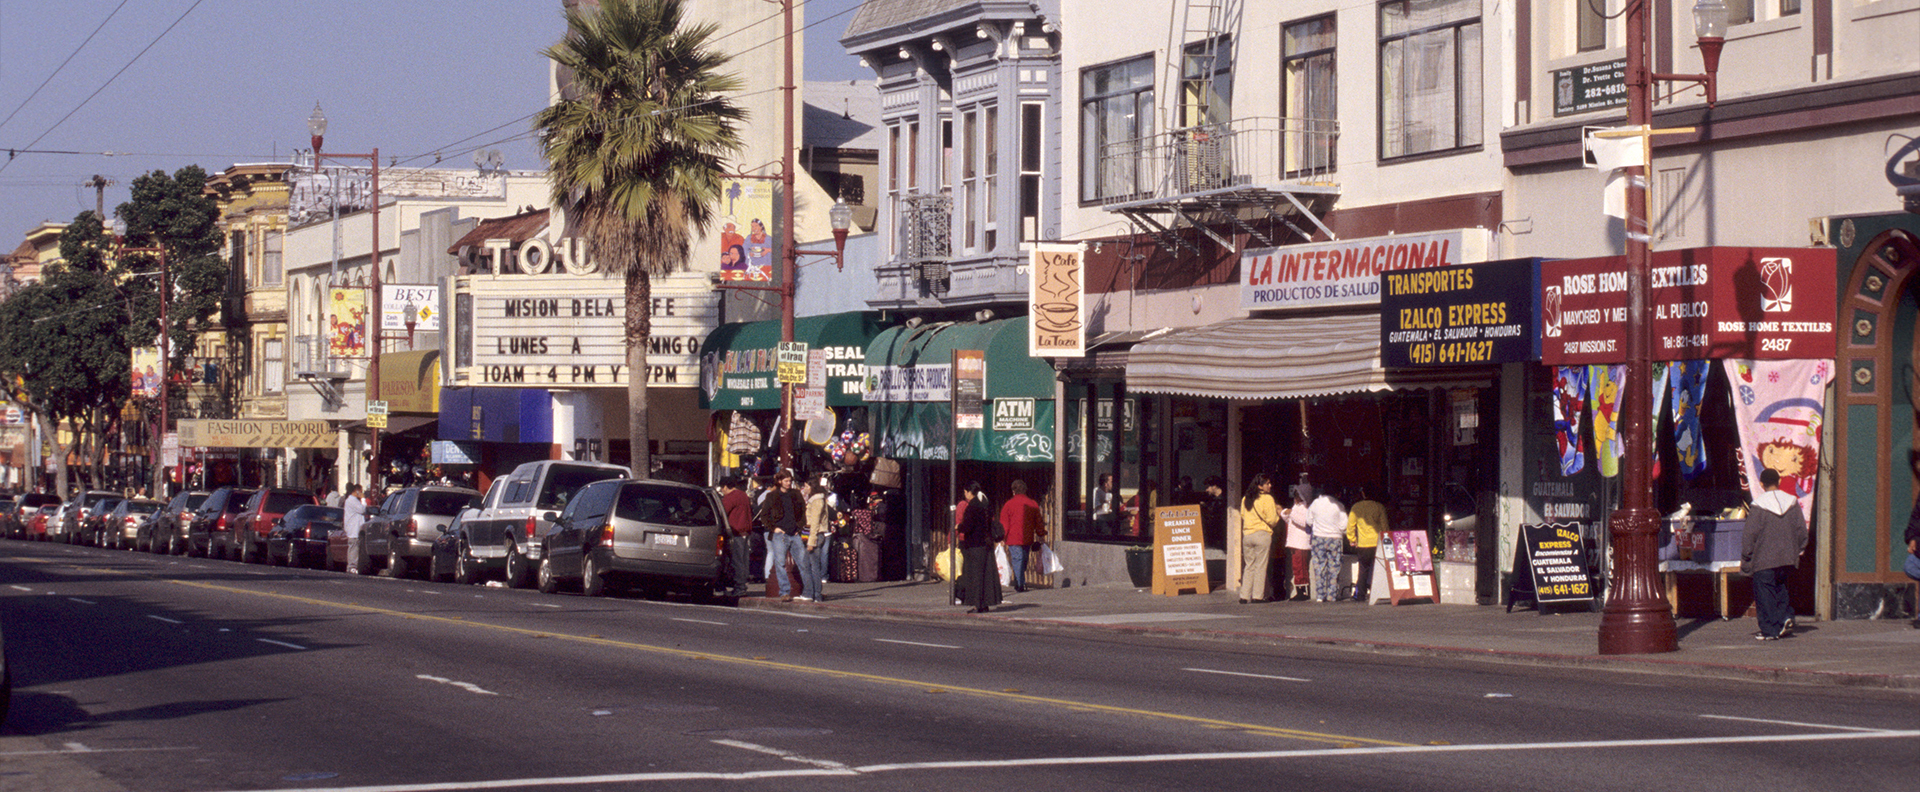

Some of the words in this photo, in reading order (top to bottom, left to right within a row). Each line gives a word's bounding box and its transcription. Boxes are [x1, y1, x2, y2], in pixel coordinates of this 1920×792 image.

[1053, 254, 1077, 266] Cafe
[1250, 256, 1272, 286] LA
[1277, 239, 1452, 283] INTERNACIONAL
[1388, 268, 1474, 295] TRANSPORTES
[1563, 273, 1596, 295] ROSE
[1599, 271, 1627, 293] HOM
[1652, 264, 1708, 290] EXTILES
[394, 289, 436, 301] BEST
[1254, 285, 1322, 303] PRODUCTOS
[1324, 284, 1340, 299] DE
[1341, 281, 1380, 298] SALUD
[504, 299, 558, 317] MISION
[1563, 308, 1600, 325] MAYOREO
[1603, 308, 1610, 323] Y
[1656, 304, 1667, 319] AL
[1670, 301, 1708, 319] PUBLICO
[1400, 307, 1442, 330] IZALCO
[1449, 302, 1506, 327] EXPRESS
[1718, 321, 1746, 332] ROSE
[1749, 321, 1779, 332] HOME
[1781, 321, 1832, 332] TEXTILES
[1389, 330, 1428, 343] GUATEMALA
[1433, 329, 1442, 340] EL
[1444, 326, 1478, 340] SALVADOR
[1484, 324, 1522, 338] HONDURAS
[497, 336, 548, 354] LUNES
[571, 336, 581, 354] A
[780, 342, 790, 351] US
[791, 342, 805, 351] Out
[1049, 335, 1076, 346] Taza
[1563, 341, 1579, 354] 2487
[1580, 340, 1606, 353] MISSION
[1606, 339, 1617, 352] ST.
[1761, 338, 1792, 351] 2487
[787, 352, 803, 362] Iraq
[823, 346, 865, 359] SEAL
[1410, 341, 1435, 364] (415)
[1439, 340, 1493, 363] 641-1627
[484, 366, 525, 382] 10AM
[547, 366, 557, 382] 4
[571, 366, 596, 382] PM
[611, 365, 621, 382] Y
[825, 364, 864, 376] TRAD
[996, 401, 1032, 417] ATM
[207, 422, 263, 434] FASHION
[1532, 482, 1574, 497] GUATEMALA
[1544, 503, 1553, 518] EL
[1554, 503, 1590, 518] SALVADOR
[1164, 519, 1196, 527] BREAKFAST
[1171, 527, 1191, 535] LUNCH
[1556, 529, 1579, 542] IZALCO
[1539, 541, 1572, 549] EXPRESS
[1532, 557, 1572, 566] GUATEMALA
[1546, 566, 1580, 574] SALVADOR
[1550, 574, 1587, 582] HONDURAS
[1537, 585, 1553, 595] (415)
[1553, 583, 1589, 595] 641-1627
